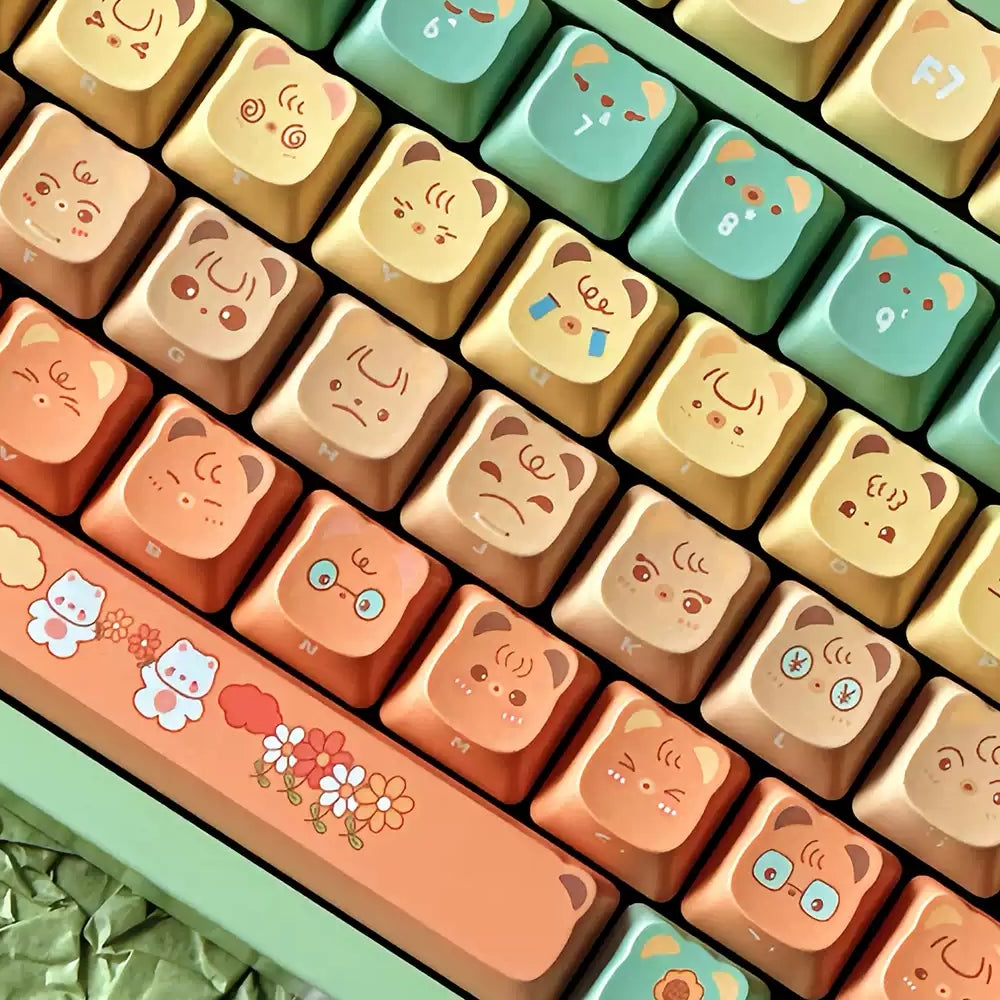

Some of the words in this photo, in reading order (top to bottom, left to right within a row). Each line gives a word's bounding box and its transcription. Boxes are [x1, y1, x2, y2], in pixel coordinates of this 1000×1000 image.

[423, 16, 439, 38] 6
[911, 55, 965, 99] F7
[574, 112, 593, 136] 7
[718, 212, 739, 236] 8
[876, 306, 895, 333] 9
[0, 445, 18, 461] V
[620, 635, 642, 657] K
